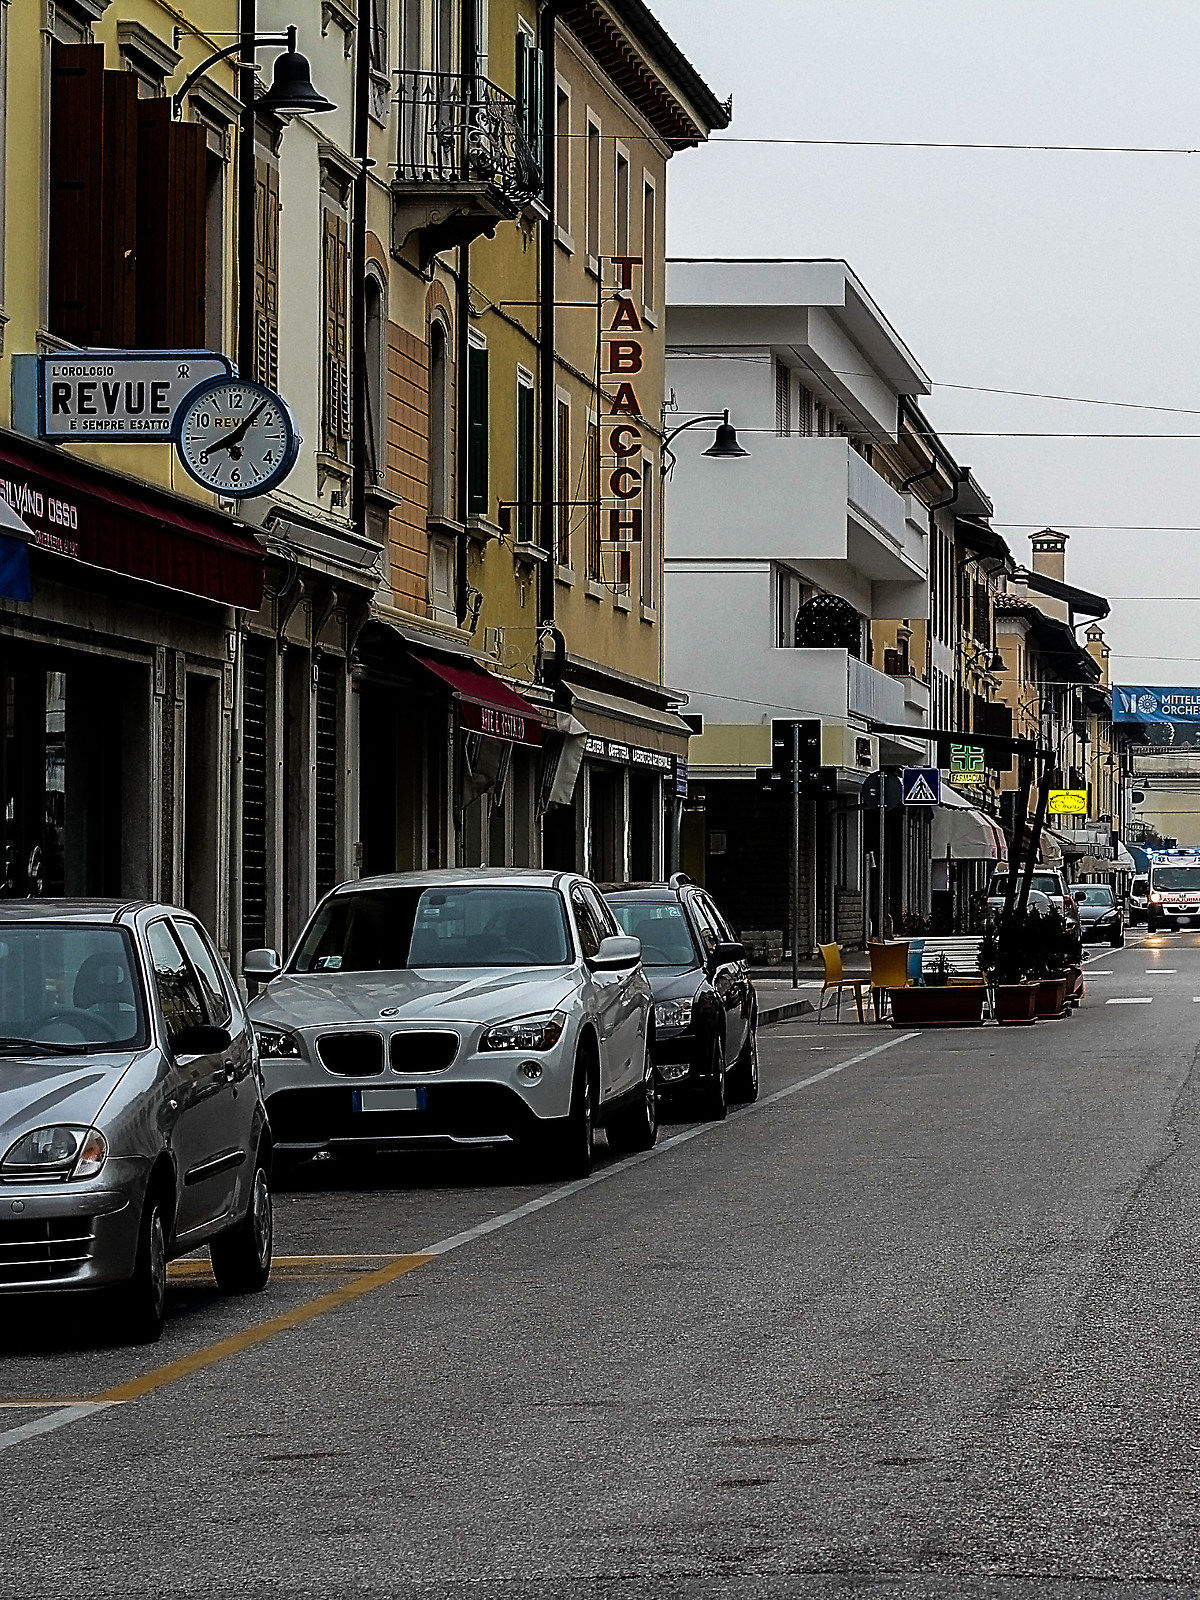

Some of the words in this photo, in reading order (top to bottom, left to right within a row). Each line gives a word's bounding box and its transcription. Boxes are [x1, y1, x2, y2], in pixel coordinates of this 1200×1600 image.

[52, 366, 114, 377] L'OROLOGIO
[52, 381, 171, 415] REVUE
[229, 393, 243, 409] 12
[82, 420, 125, 430] SEMPRE
[130, 420, 170, 430] ESATTO
[196, 413, 210, 428] 10
[264, 412, 274, 426] 2
[609, 257, 643, 584] TABACCHI
[199, 451, 209, 465] 8
[263, 450, 273, 465] 4
[230, 468, 241, 482] 6
[48, 497, 78, 530] OSSO
[951, 773, 983, 783] FARMACIA
